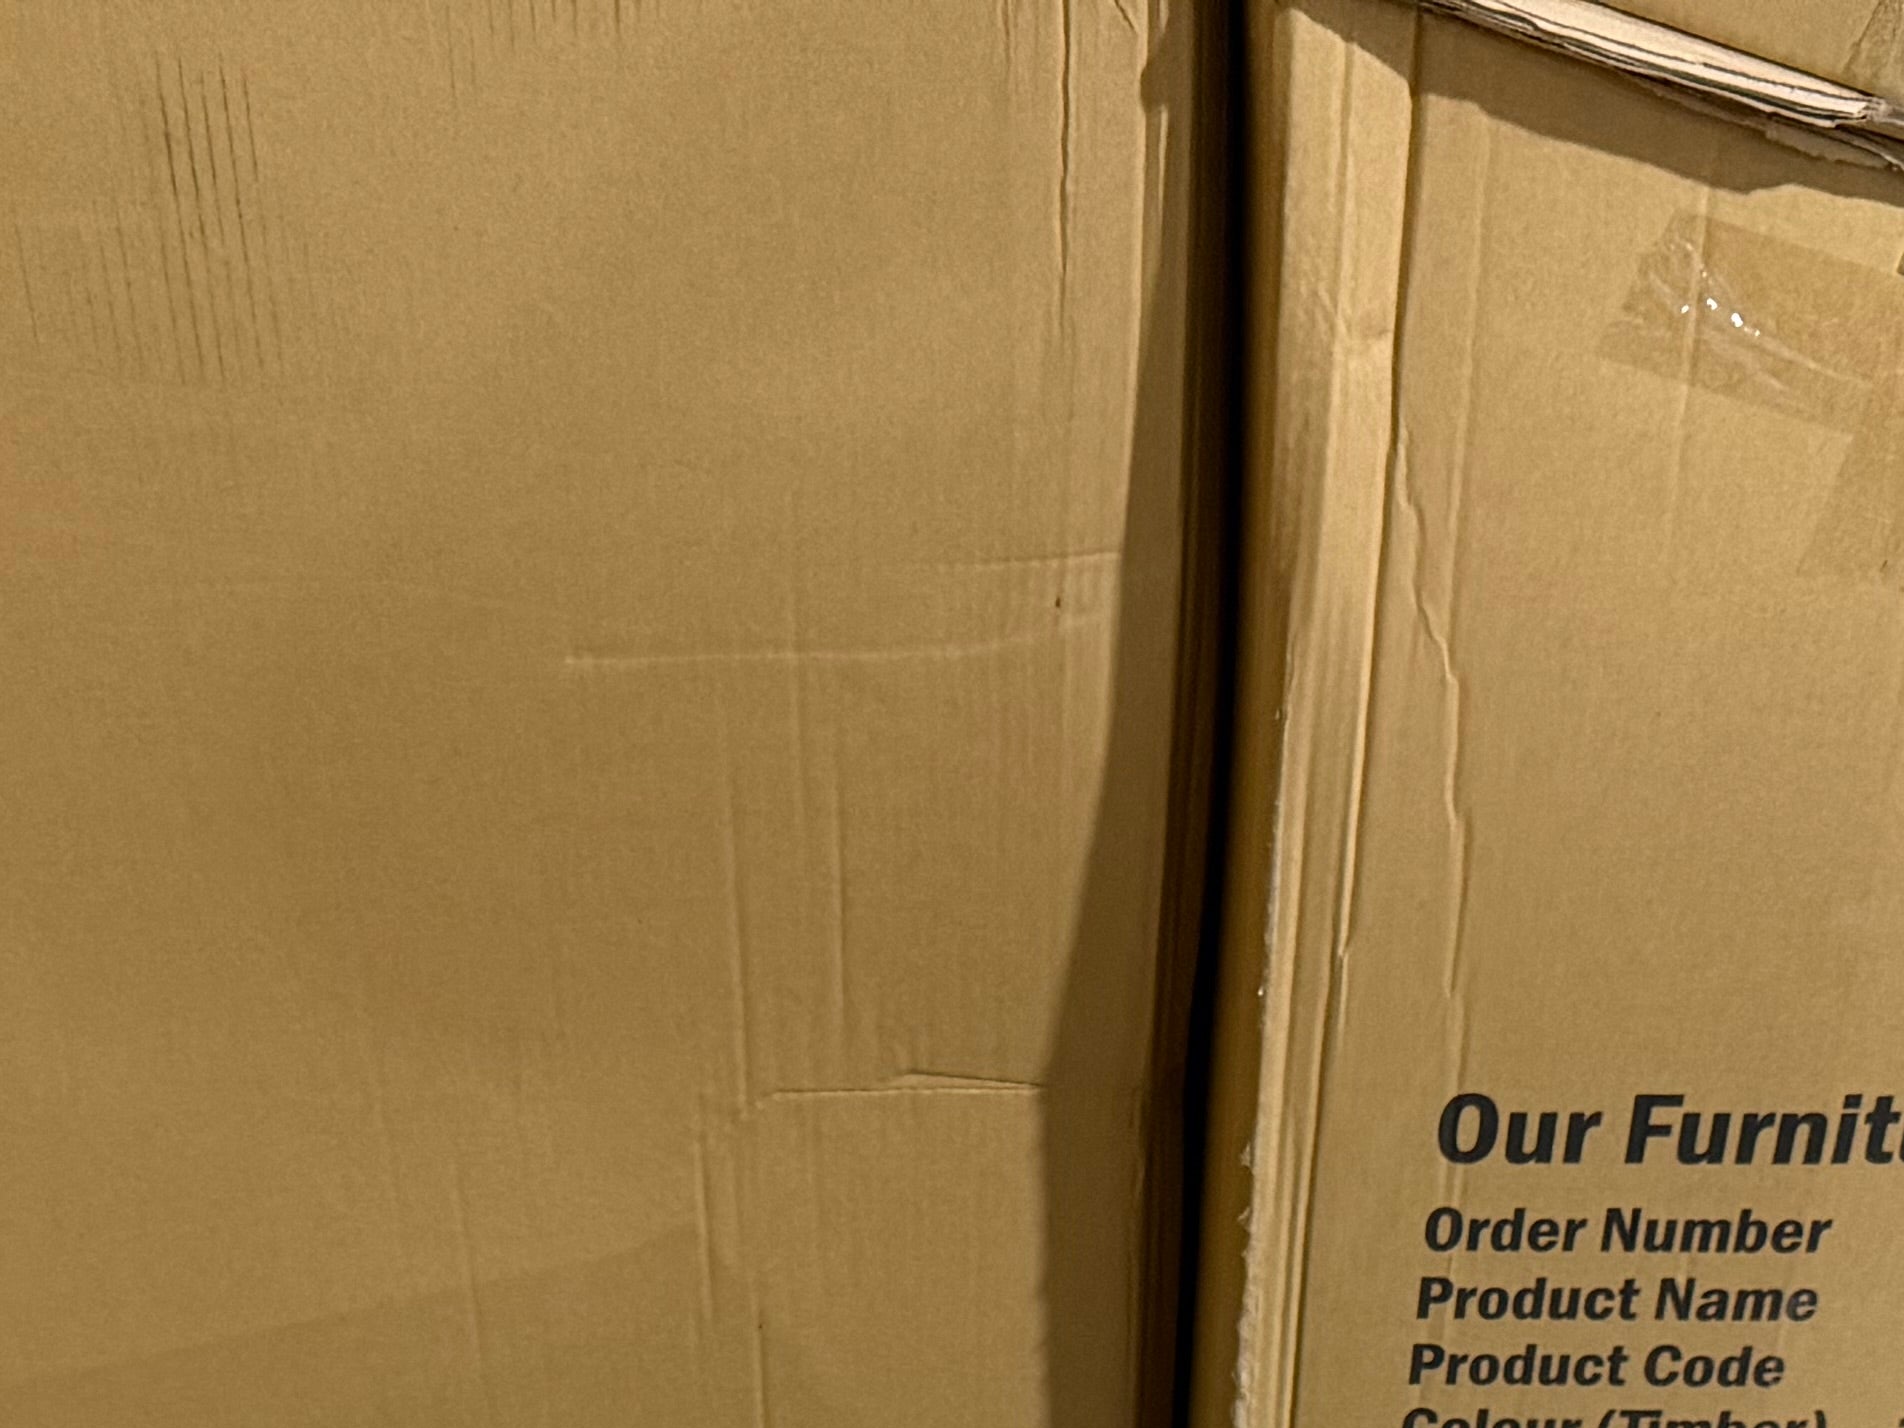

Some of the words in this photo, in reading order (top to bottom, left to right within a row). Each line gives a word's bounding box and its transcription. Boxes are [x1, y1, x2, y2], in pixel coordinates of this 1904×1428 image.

[1437, 1092, 1604, 1165] Our
[1424, 1206, 1589, 1253] Order
[1600, 1207, 1834, 1254] Number
[1416, 1276, 1642, 1321] Product
[1653, 1276, 1818, 1322] Name
[1408, 1343, 1630, 1387] Product
[1643, 1344, 1785, 1389] Code
